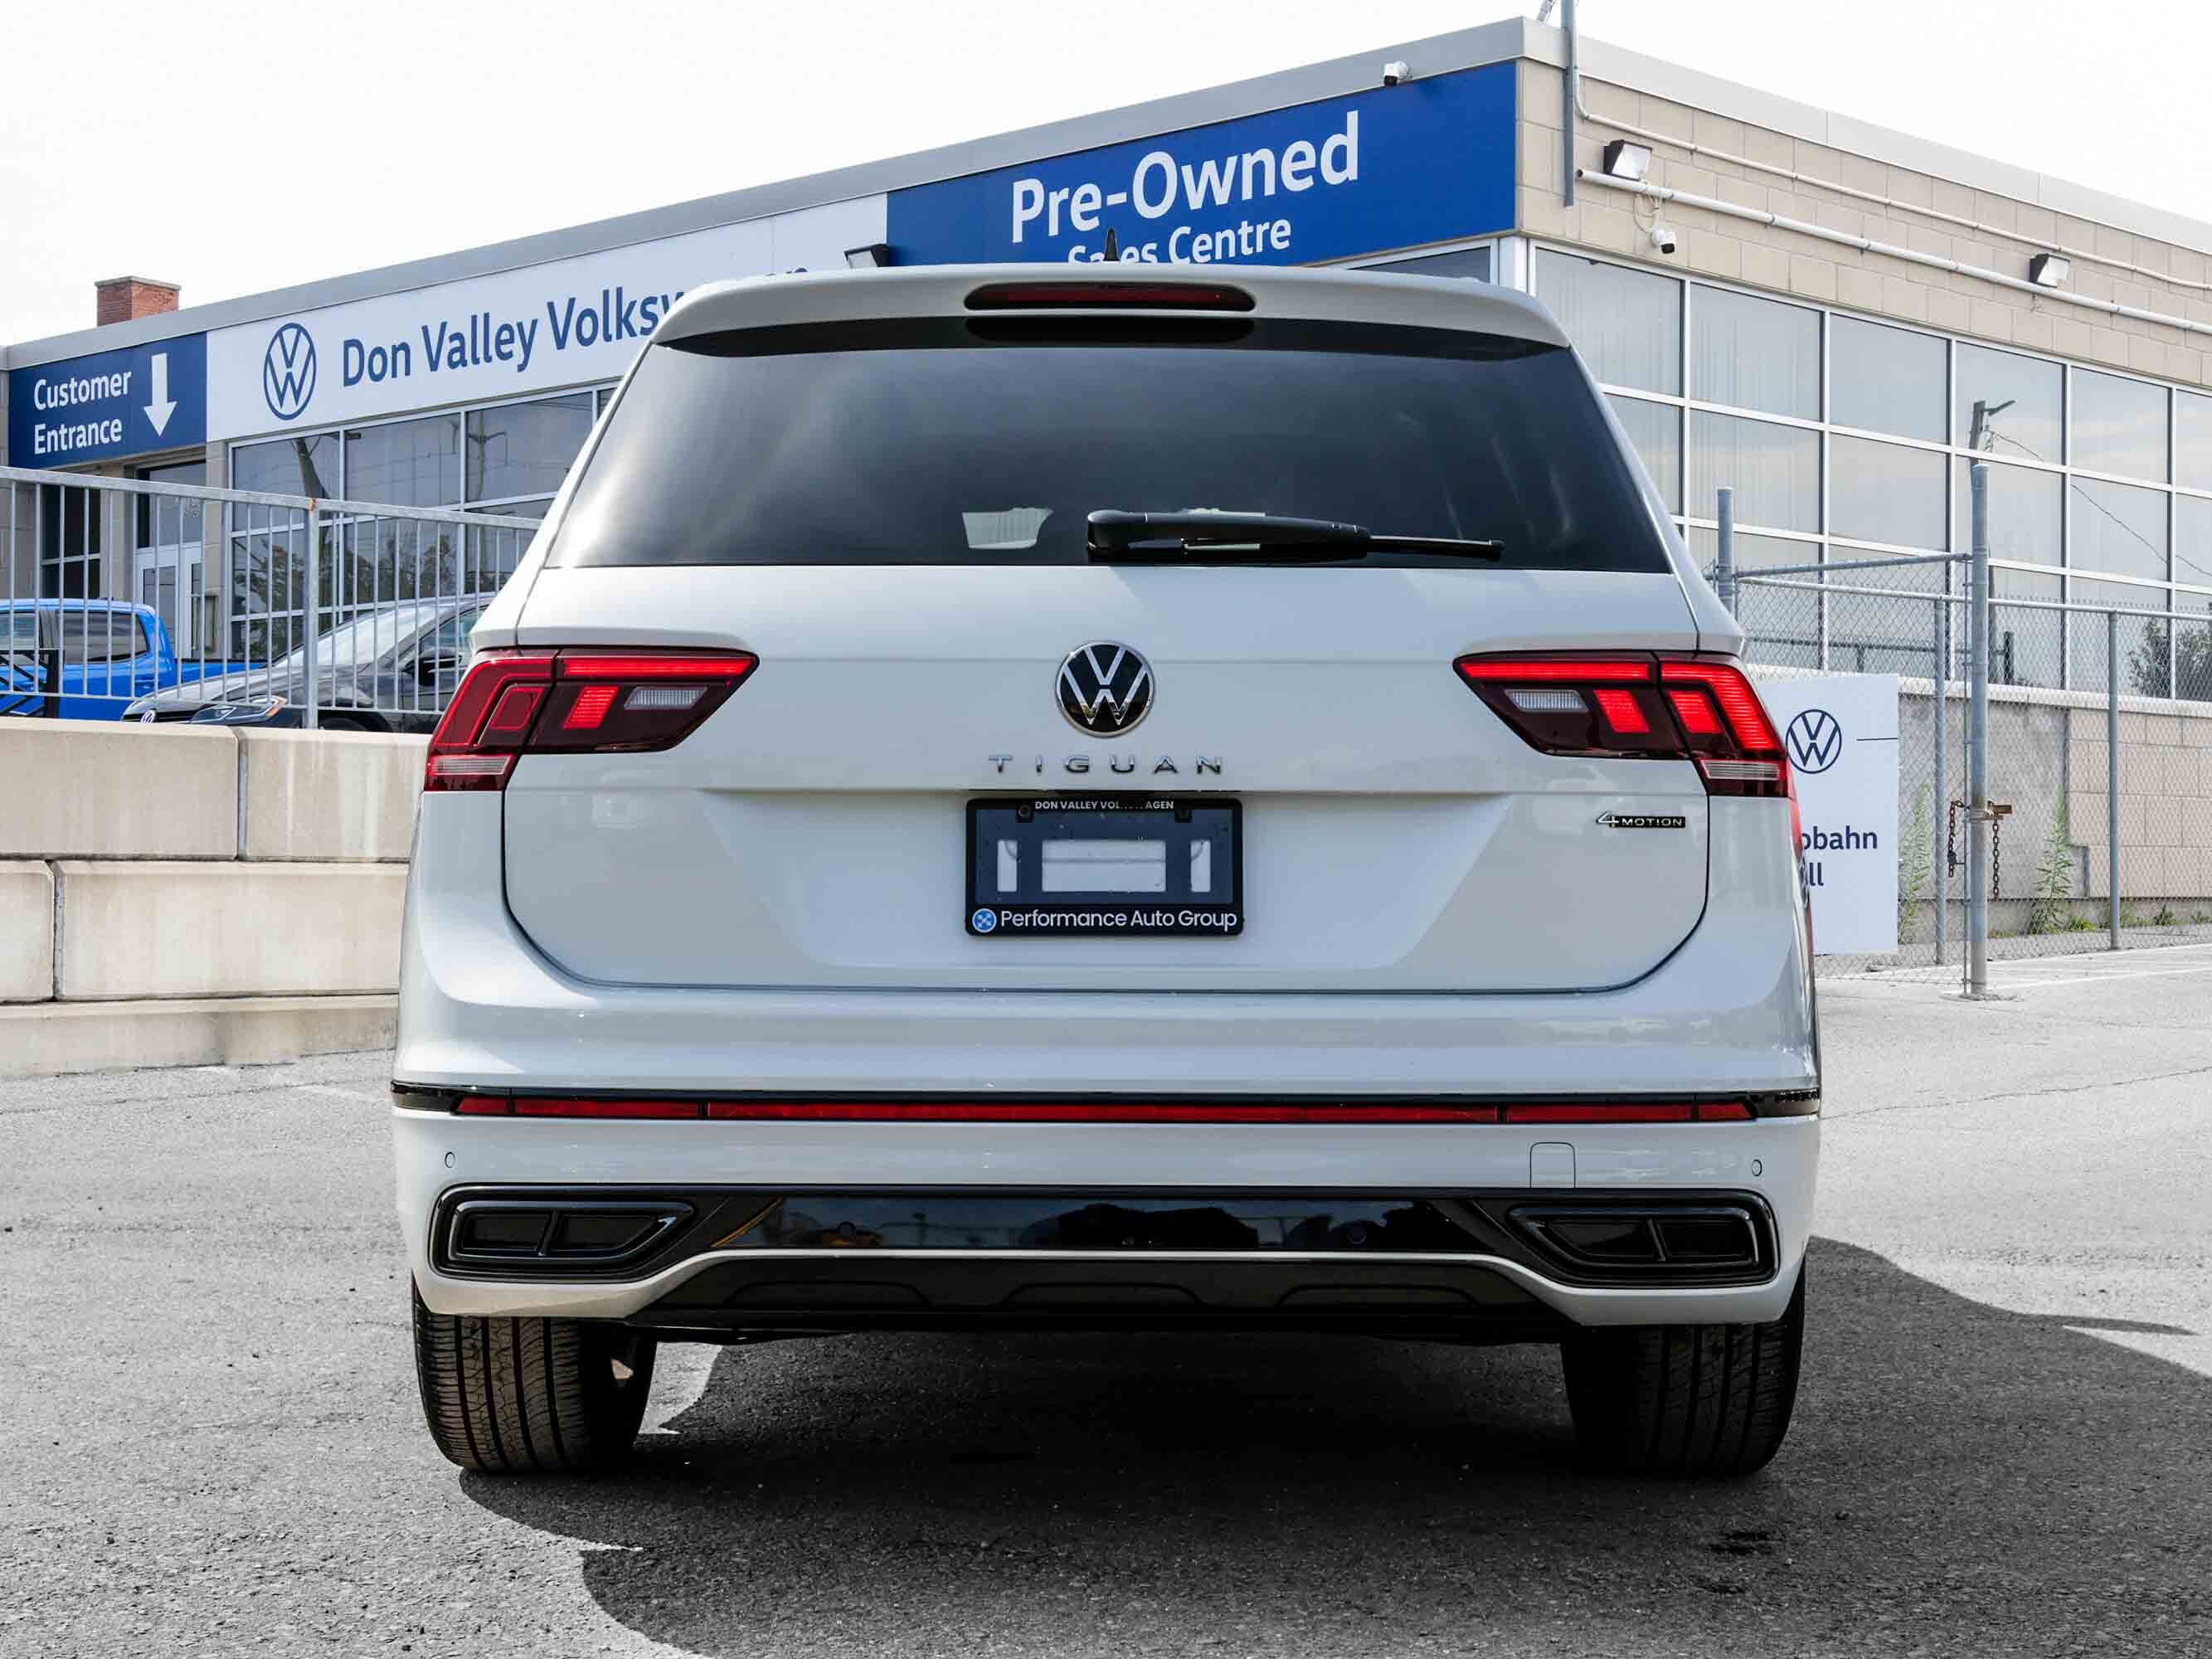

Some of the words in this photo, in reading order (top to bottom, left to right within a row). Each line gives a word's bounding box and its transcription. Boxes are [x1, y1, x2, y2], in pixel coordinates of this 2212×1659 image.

[1012, 109, 1359, 244] Pre-Owned
[1168, 218, 1291, 265] Centre
[343, 338, 412, 388] Don
[421, 312, 539, 373] Valley
[33, 370, 133, 411] Customer
[33, 417, 123, 455] Entrance
[1059, 643, 1154, 733] VW
[988, 755, 1223, 776] TIGUAN
[1034, 800, 1058, 810] DON
[1060, 800, 1098, 810] VALLEY
[1100, 800, 1174, 810] VOLAGEN
[1595, 810, 1684, 828] 4MOTION
[1000, 909, 1127, 927] Performance
[1130, 910, 1175, 927] Auto
[1178, 909, 1237, 932] Group
